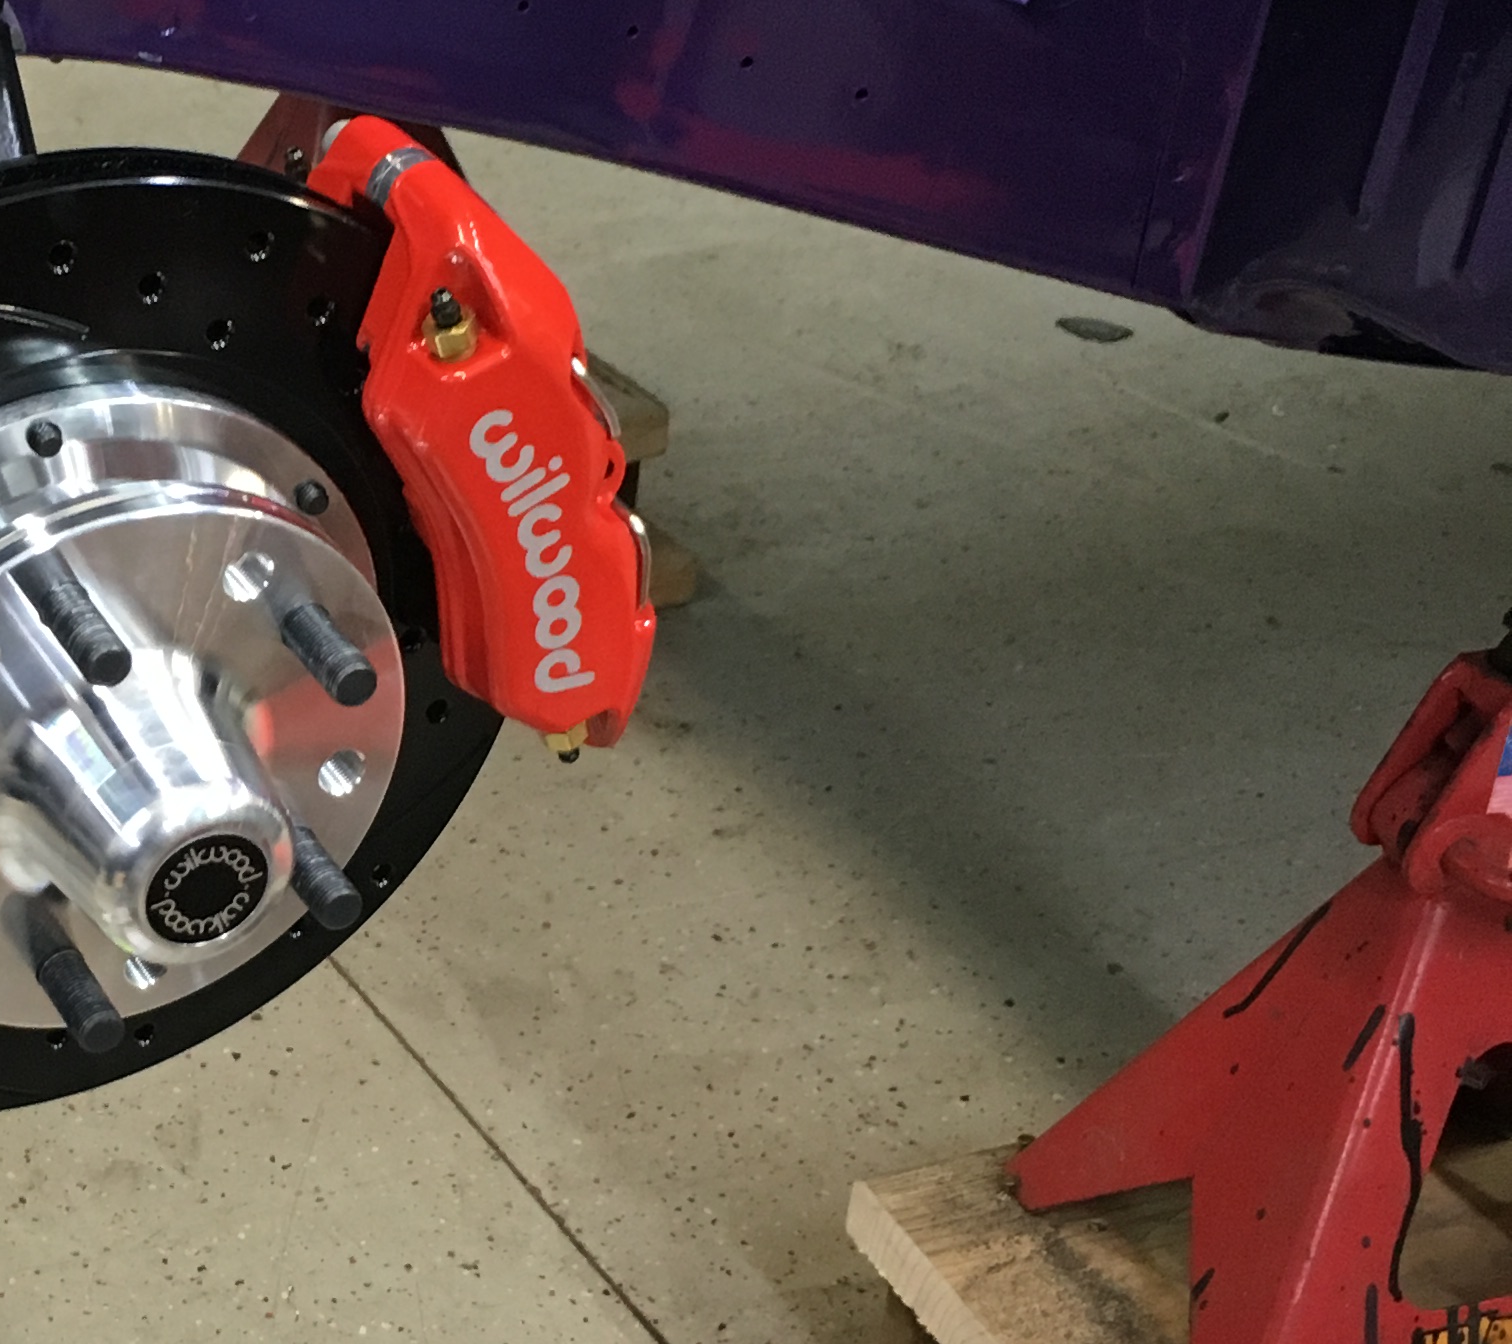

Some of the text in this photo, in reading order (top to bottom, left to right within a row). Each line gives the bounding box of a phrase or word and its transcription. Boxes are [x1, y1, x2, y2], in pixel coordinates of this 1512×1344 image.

[468, 408, 596, 695] wilwood
[163, 844, 263, 891] wilwood
[149, 891, 251, 936] wilwood
